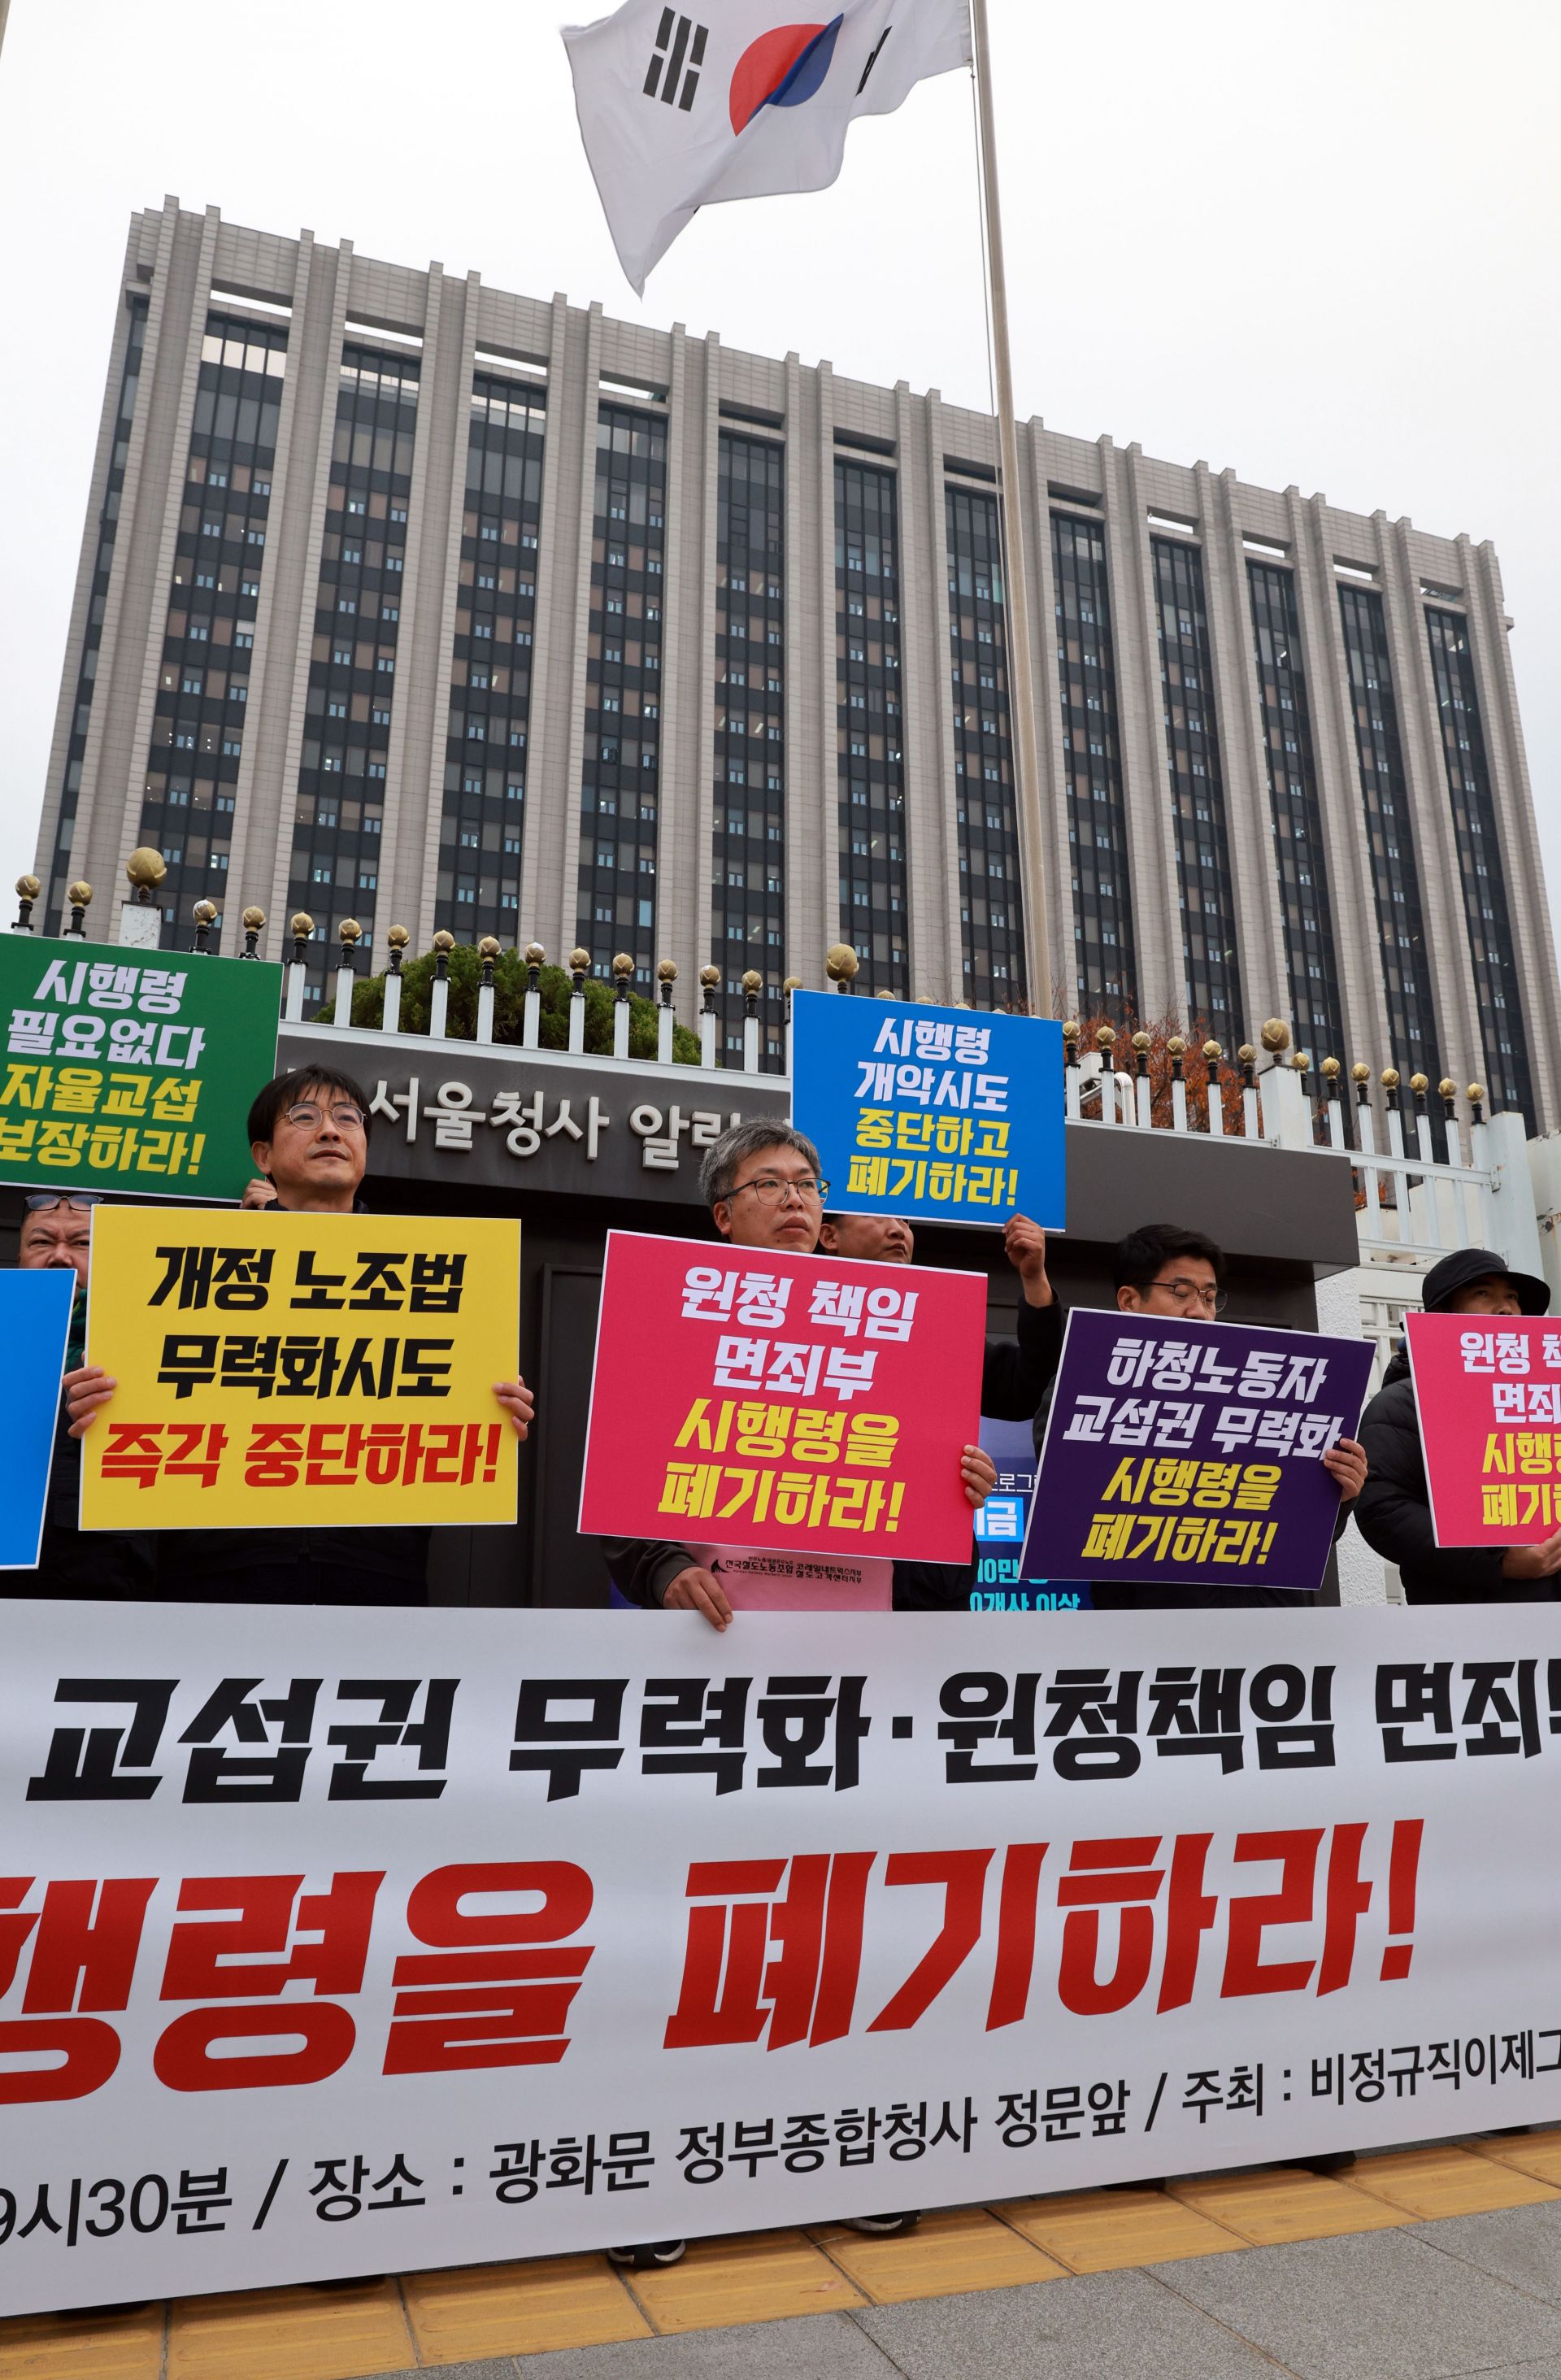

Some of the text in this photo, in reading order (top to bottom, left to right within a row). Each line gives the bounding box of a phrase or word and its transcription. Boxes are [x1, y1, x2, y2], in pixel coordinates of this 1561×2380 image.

[33, 959, 188, 1015] 시행령
[7, 1009, 206, 1069] 필요없다
[873, 1017, 991, 1065] 시행령
[0, 1064, 202, 1122] 자율교섭
[854, 1061, 1009, 1112] 개악시도
[0, 1117, 206, 1175] 보장하라!
[856, 1107, 1009, 1158] 중단하고
[847, 1155, 1018, 1205] 폐기하라!
[147, 1247, 467, 1313] 개정 노조법
[681, 1266, 920, 1342] 원청 책임
[157, 1334, 454, 1400] 무력화시도
[713, 1335, 879, 1401] 면죄부
[1107, 1338, 1329, 1403] 하청노동자
[1460, 1332, 1531, 1375] 원청
[101, 1423, 502, 1489] 즉각 중단하라!
[675, 1398, 900, 1468] 시행령을
[1063, 1394, 1344, 1460] 교섭권 무력화
[1482, 1432, 1561, 1475] 시행
[658, 1462, 906, 1533] 폐기하라!
[991, 1473, 1037, 1493] 로그
[1102, 1457, 1282, 1511] 시행령을
[1482, 1483, 1561, 1526] 폐기
[1081, 1513, 1278, 1565] 폐기하라!
[25, 1677, 461, 1804] 교섭권
[1375, 1658, 1561, 1763] 면죄
[663, 1818, 1424, 2051] 폐기하라!
[308, 2153, 426, 2222] 장소
[489, 2130, 655, 2204] 광화문
[675, 2096, 978, 2185] 정부종합청사
[994, 2079, 1131, 2148] 정문앞
[1182, 2063, 1263, 2124] 주최
